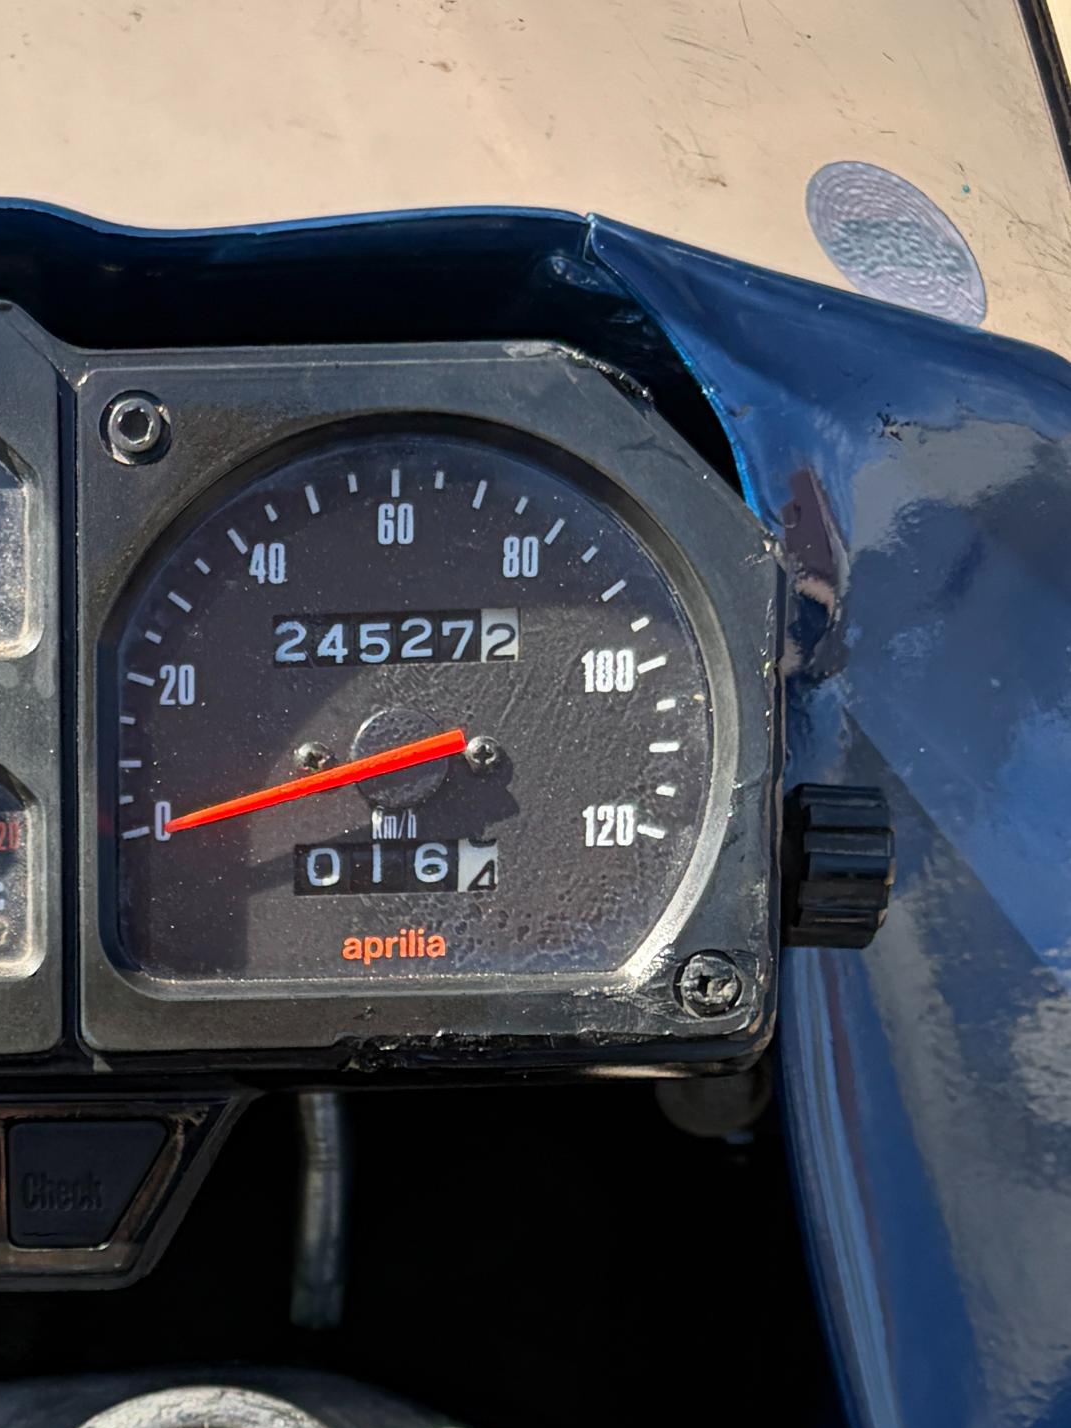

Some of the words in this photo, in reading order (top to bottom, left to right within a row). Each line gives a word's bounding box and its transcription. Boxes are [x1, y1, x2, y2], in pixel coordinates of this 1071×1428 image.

[378, 503, 414, 545] 60
[249, 543, 286, 584] 40
[503, 537, 539, 577] 80
[275, 618, 517, 664] 245272
[159, 664, 195, 705] 20
[155, 801, 171, 841] 0
[582, 804, 633, 846] 120
[341, 928, 446, 965] aprilia
